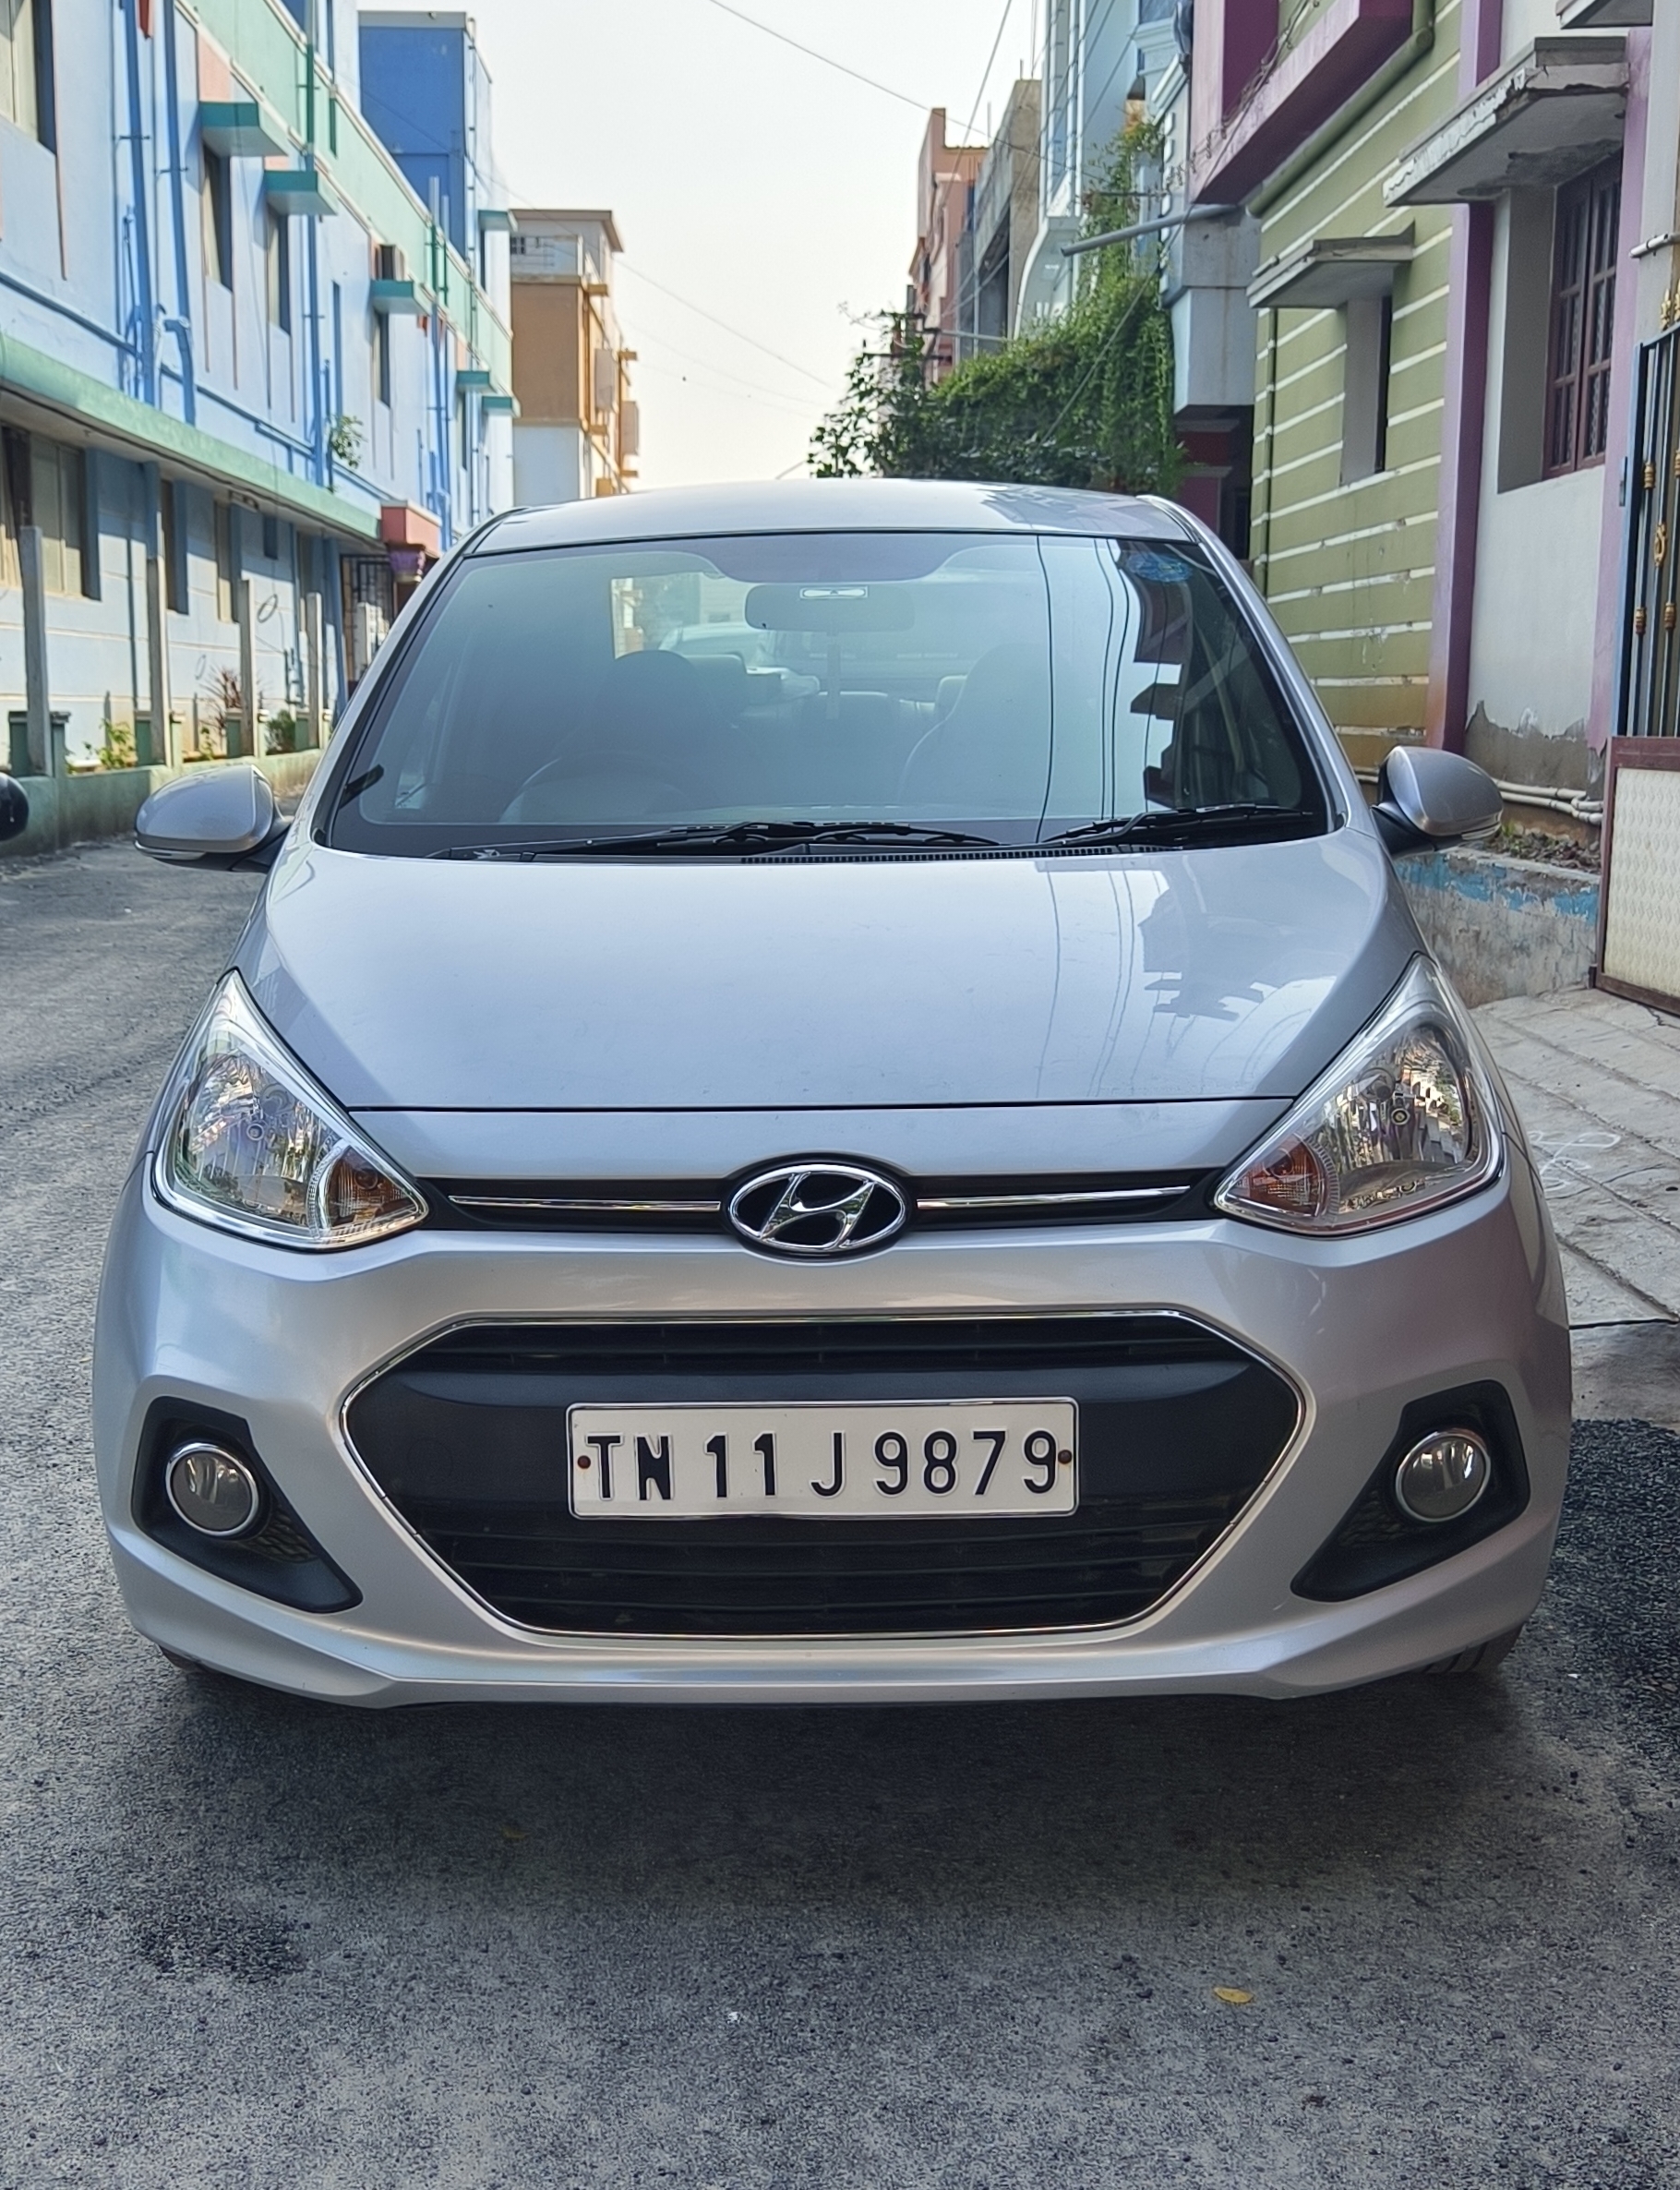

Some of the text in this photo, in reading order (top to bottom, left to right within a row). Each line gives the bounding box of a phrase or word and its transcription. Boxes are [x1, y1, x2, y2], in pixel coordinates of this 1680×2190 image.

[587, 1430, 1057, 1501] TN 11 J 9879
